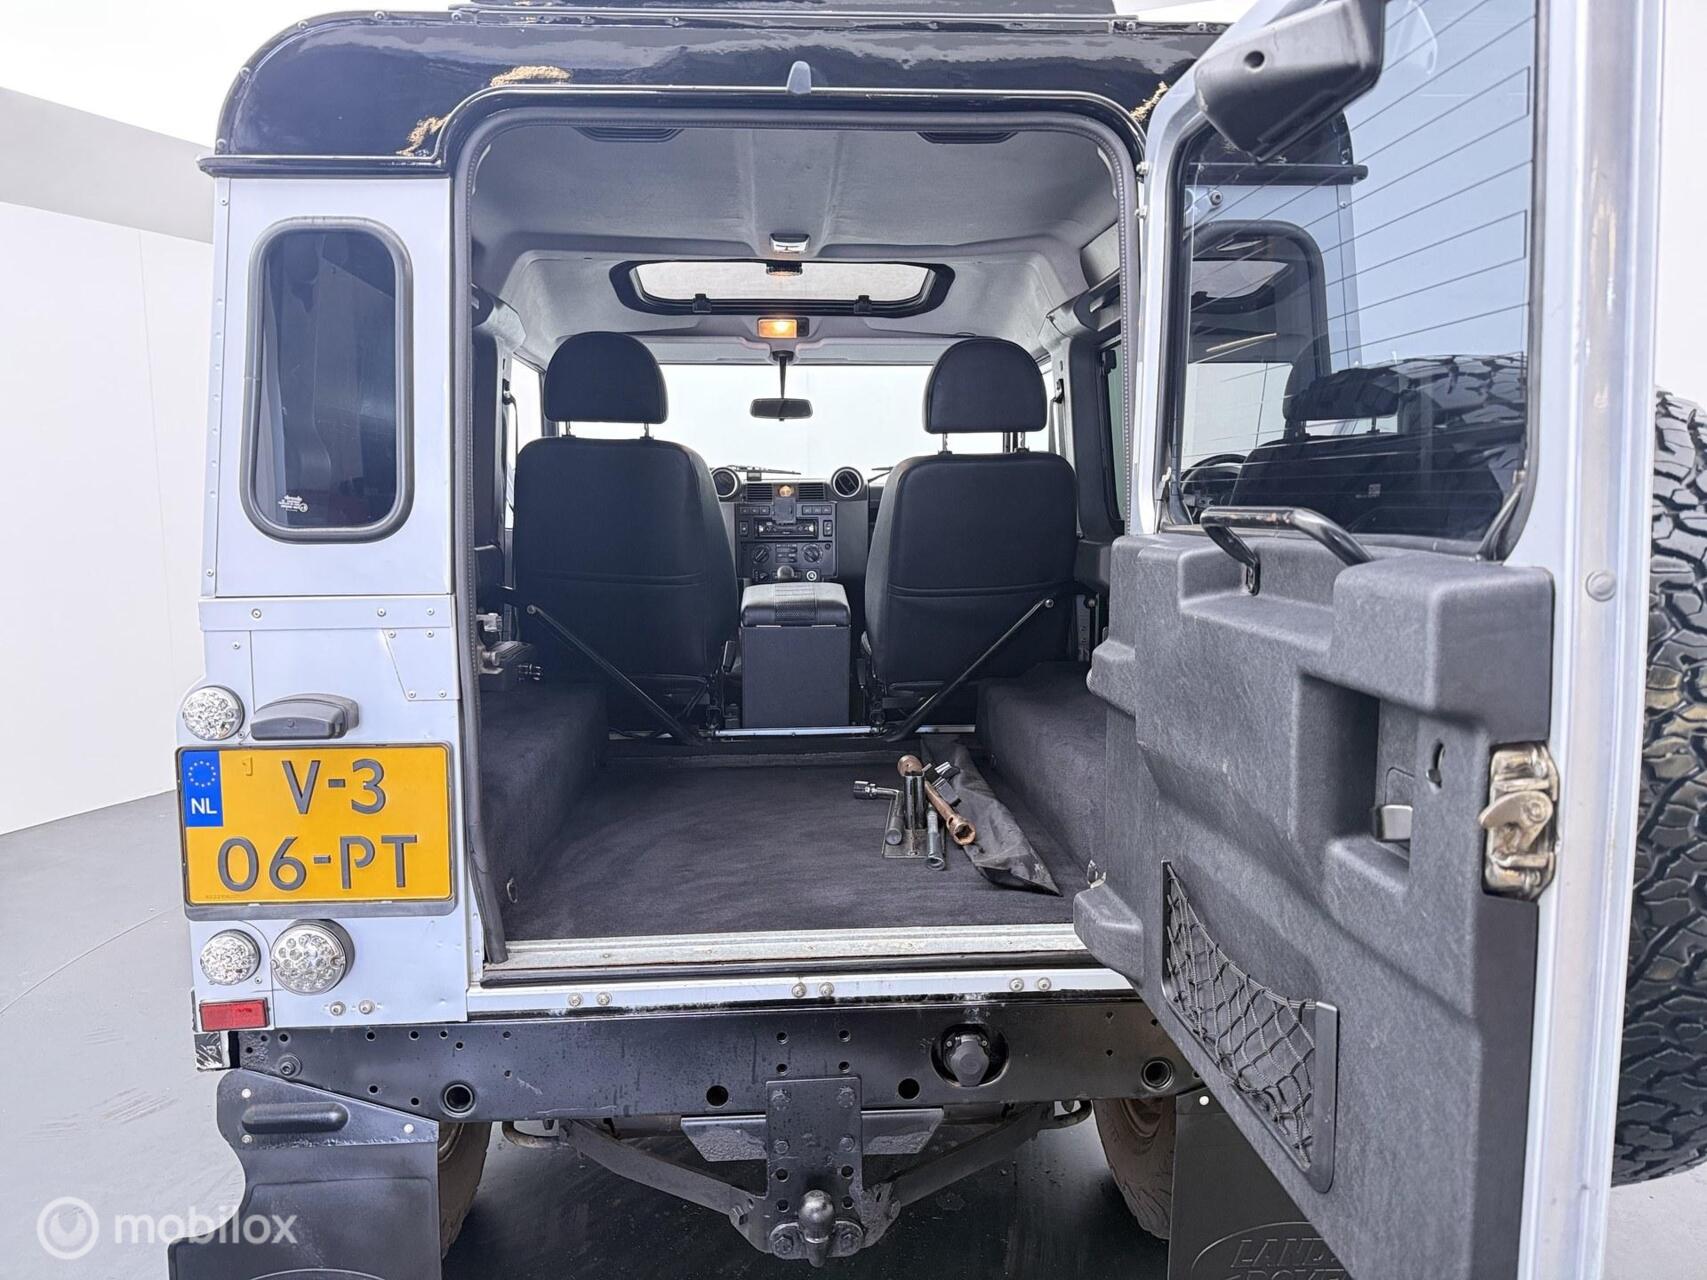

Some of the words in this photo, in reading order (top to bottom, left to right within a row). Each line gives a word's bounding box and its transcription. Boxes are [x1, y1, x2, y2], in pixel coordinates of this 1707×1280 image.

[191, 797, 217, 814] NL
[281, 758, 387, 815] V-3
[217, 834, 418, 892] 06-PT
